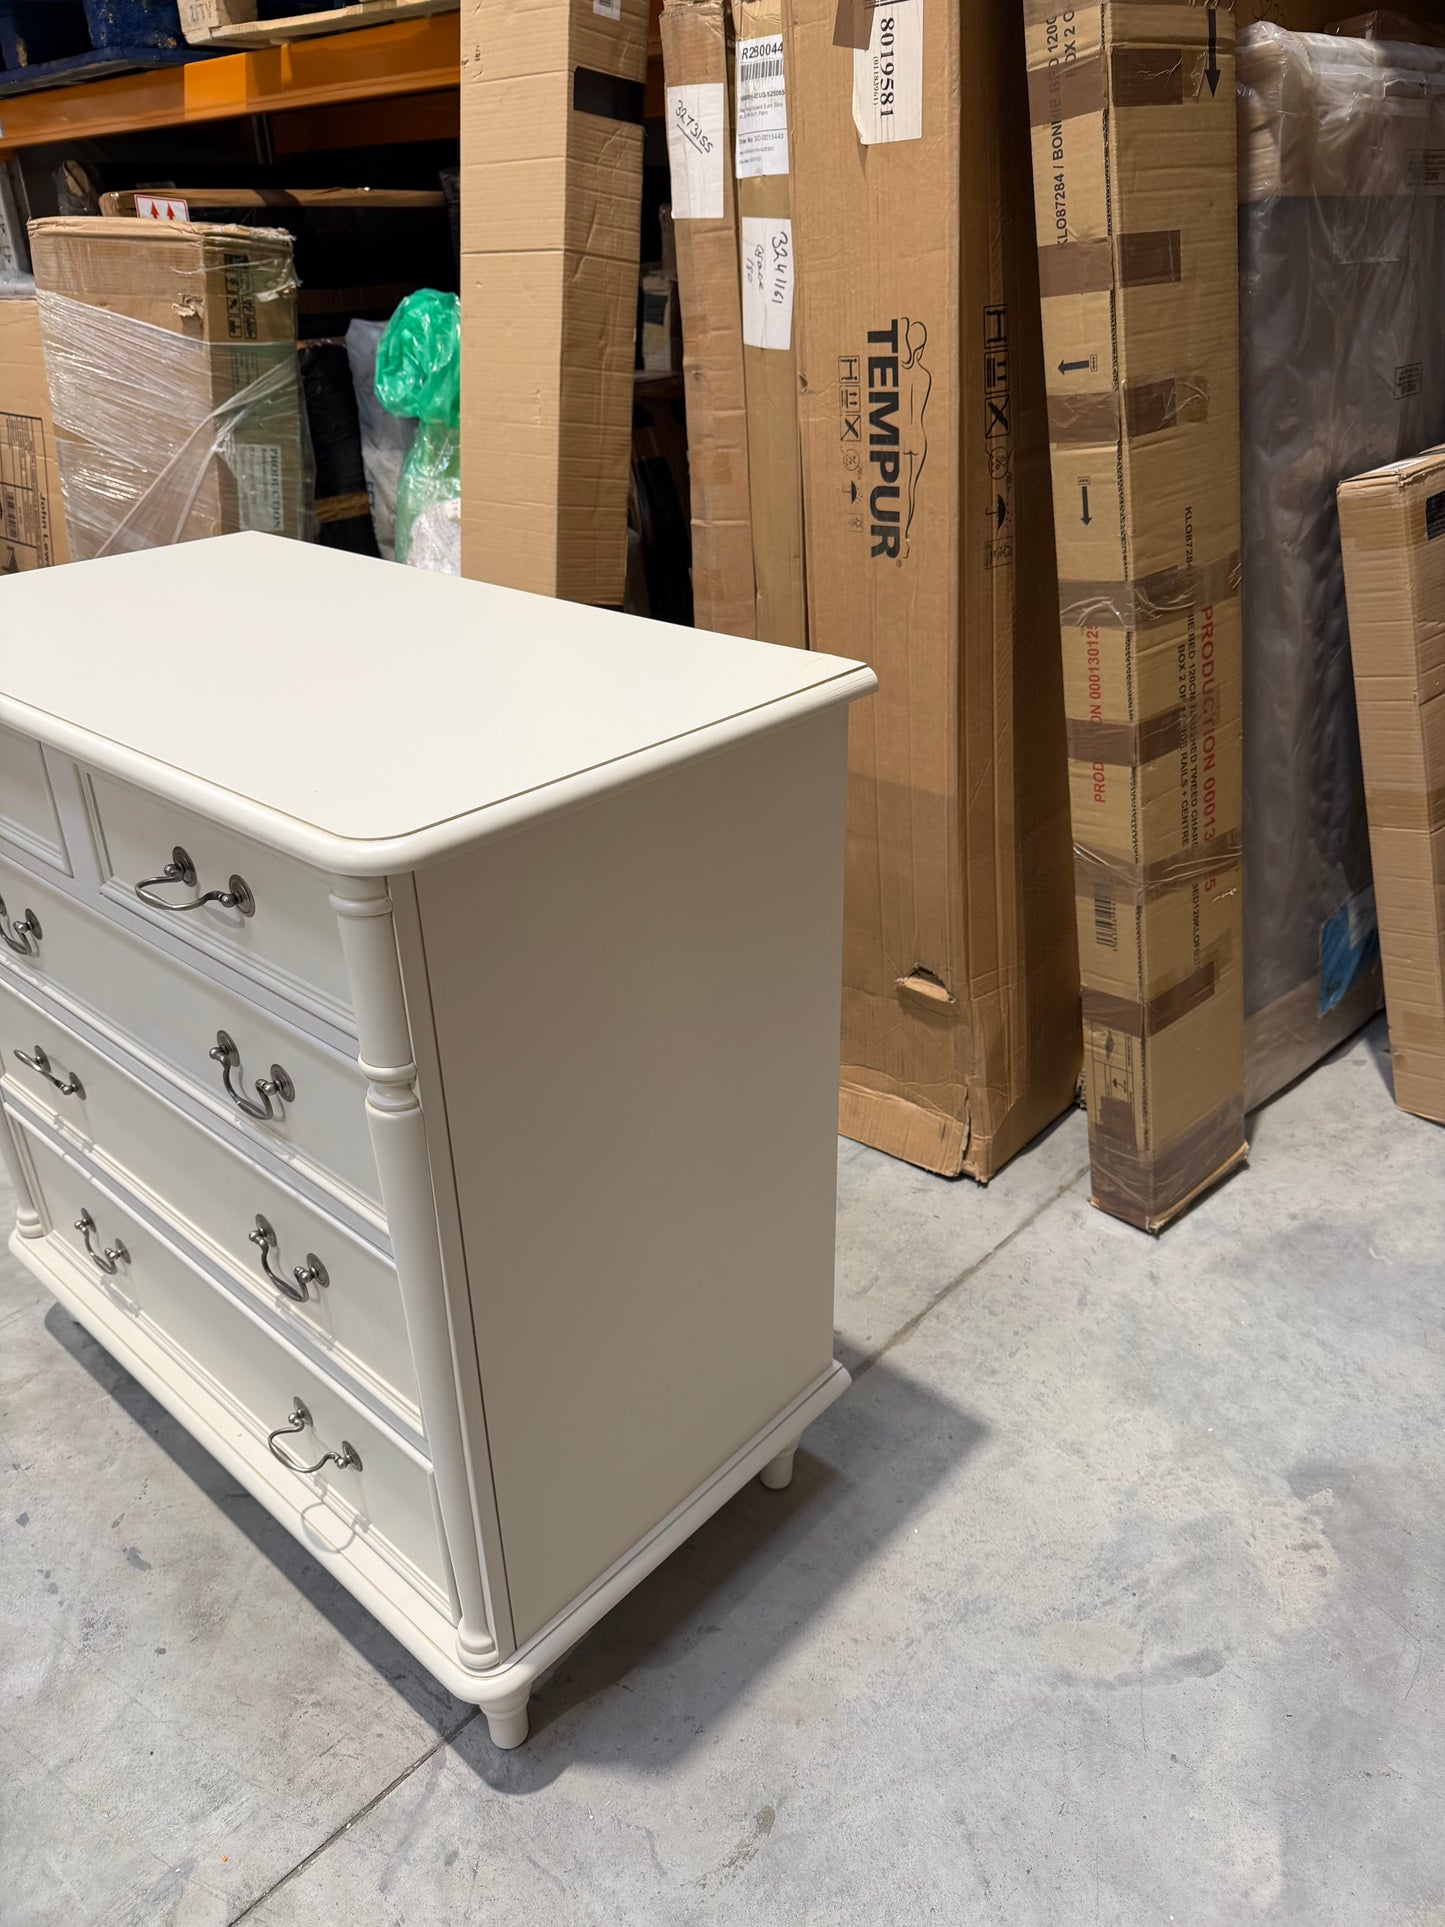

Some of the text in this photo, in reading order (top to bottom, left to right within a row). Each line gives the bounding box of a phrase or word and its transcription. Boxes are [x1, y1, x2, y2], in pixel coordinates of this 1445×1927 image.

[1045, 16, 1058, 53] 120C
[1063, 27, 1075, 37] 2
[880, 17, 895, 118] 8019581
[867, 319, 900, 559] TEMPUR
[1177, 645, 1187, 671] BOX
[1188, 633, 1196, 659] BED
[1179, 674, 1187, 683] 2
[1202, 606, 1215, 771] PRODUCTION
[1181, 752, 1189, 787] RAILS
[1190, 764, 1199, 807] TWEED
[1181, 800, 1189, 847] CENTRE
